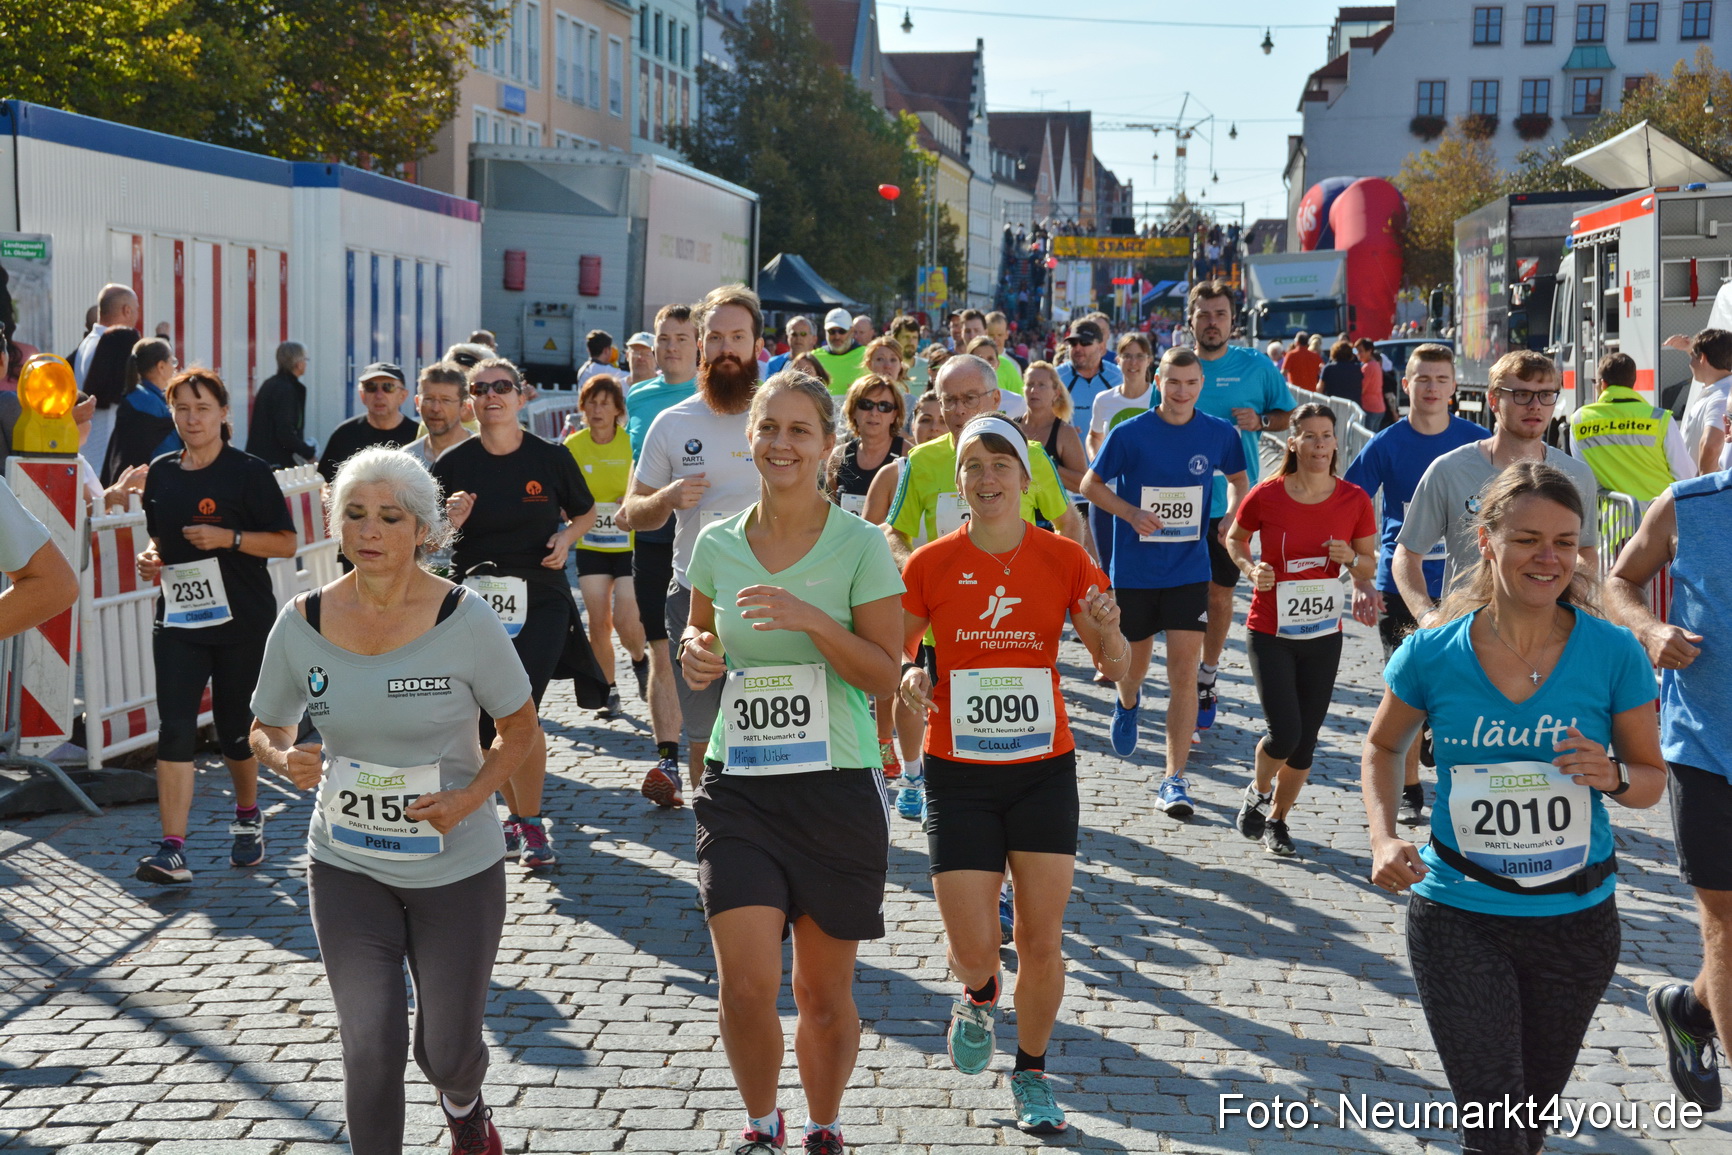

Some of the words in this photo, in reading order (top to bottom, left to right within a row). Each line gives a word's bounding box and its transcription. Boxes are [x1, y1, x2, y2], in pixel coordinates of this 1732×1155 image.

[3, 241, 43, 250] Landtagswahl
[1098, 241, 1145, 252] START
[1580, 420, 1652, 435] Org.-Leiter
[1150, 502, 1193, 519] 2589
[592, 515, 617, 529] 54
[1160, 528, 1181, 536] Kevin
[172, 579, 214, 603] 2331
[1288, 596, 1334, 617] 2454
[185, 610, 214, 622] Claudia
[1300, 623, 1320, 634] Steffi
[955, 629, 1036, 643] funrunners
[980, 640, 1044, 651] neumarkt
[388, 677, 451, 693] BOCK
[744, 675, 793, 689] BOCK
[980, 676, 1023, 688] BOCK
[308, 701, 330, 710] PARTL
[733, 694, 811, 731] 3089
[966, 694, 1039, 724] 3090
[743, 734, 761, 742] PARTL
[763, 732, 796, 741] Neumarkt
[978, 738, 1022, 750] Claudi
[357, 772, 406, 787] BOCK
[1489, 773, 1550, 788] BOCK
[1471, 796, 1572, 837] 2010
[348, 820, 372, 831] PARTL
[373, 825, 408, 834] Neumarkt
[365, 836, 401, 850] Petra
[1484, 841, 1511, 850] PARTL
[1513, 839, 1553, 850] Neumarkt
[1499, 858, 1552, 875] Janina
